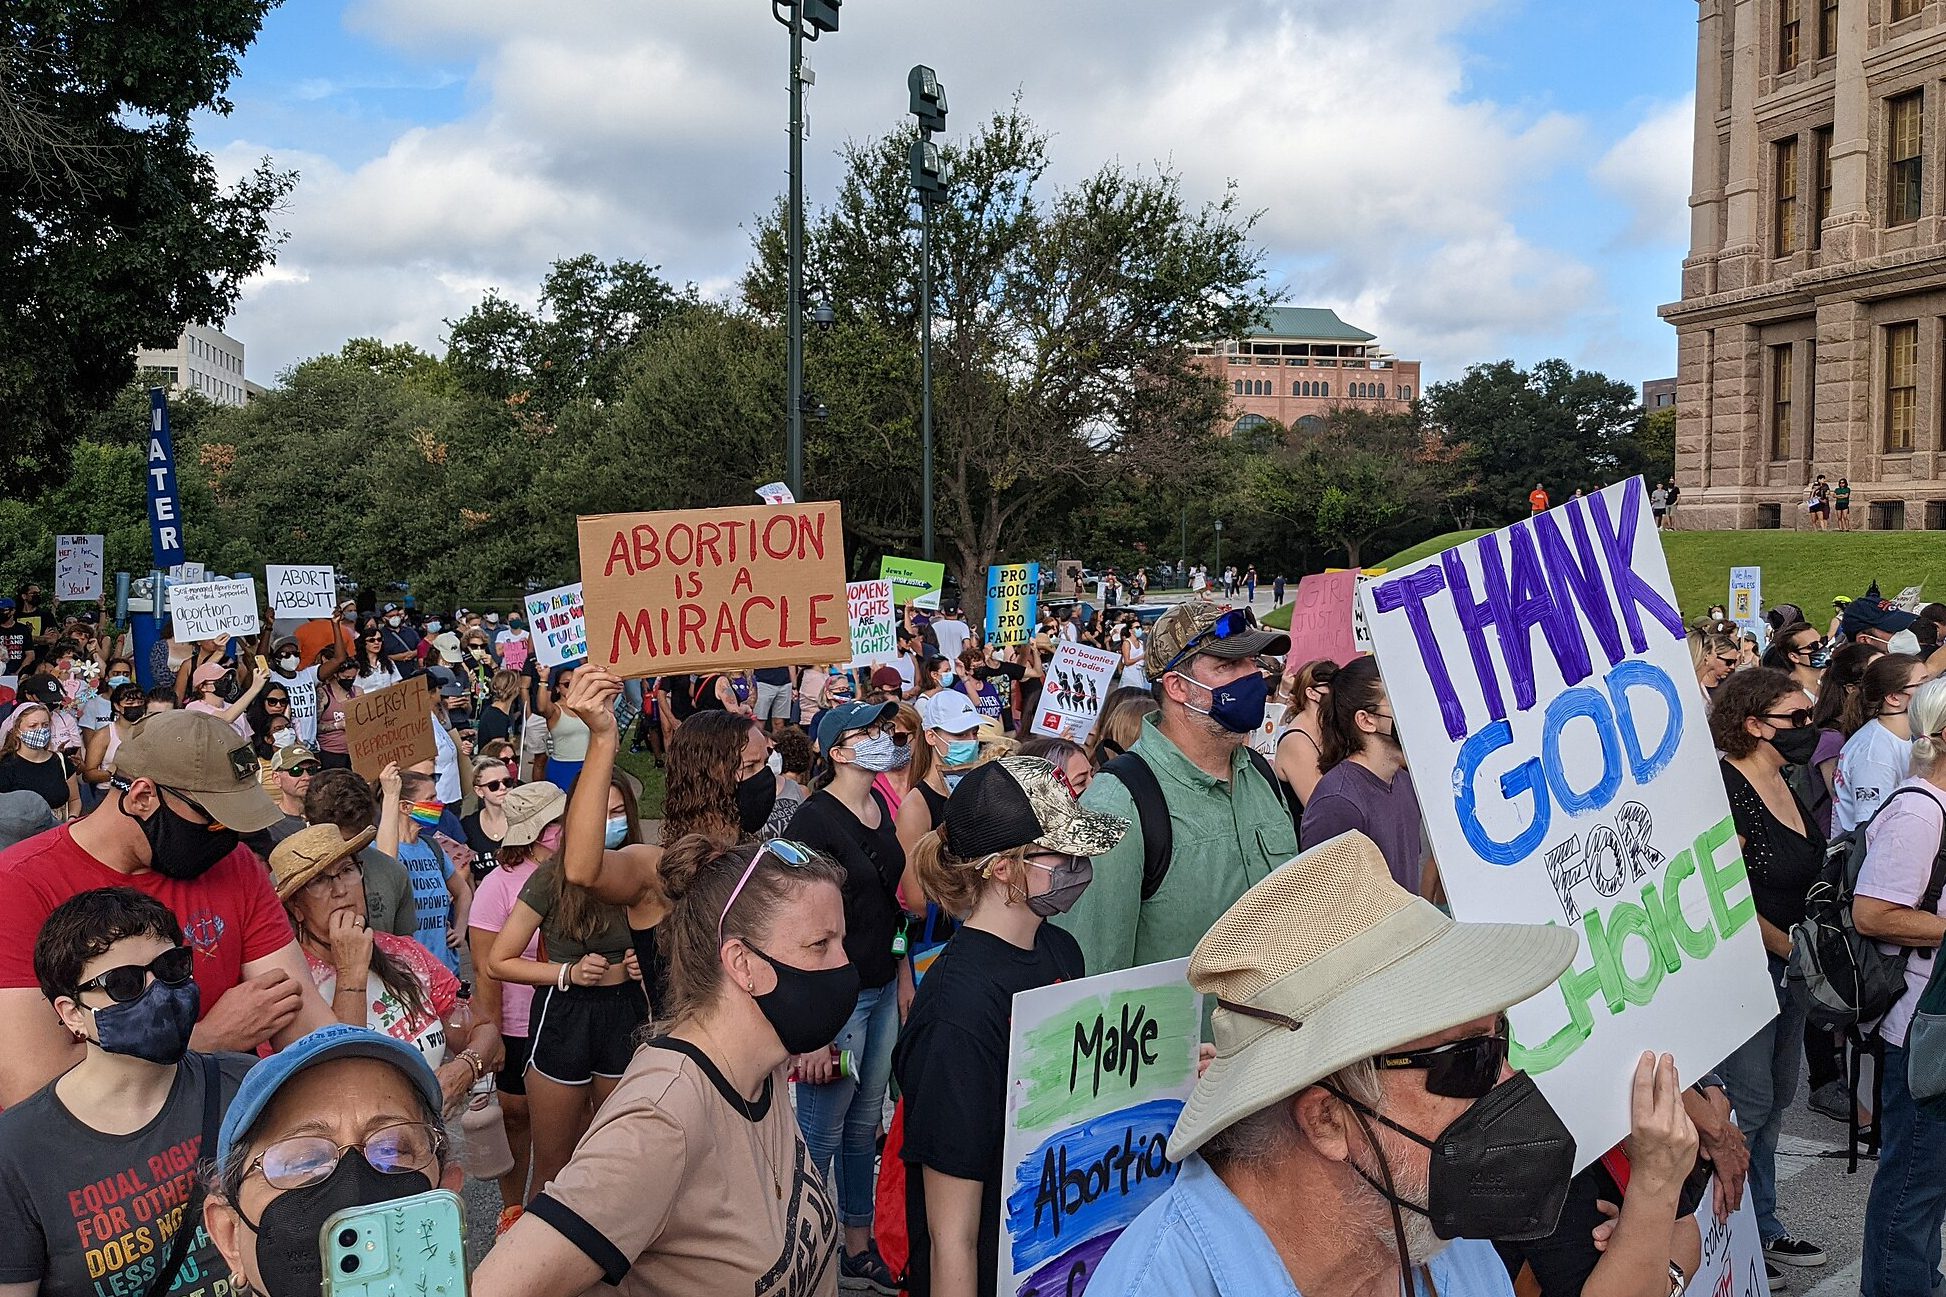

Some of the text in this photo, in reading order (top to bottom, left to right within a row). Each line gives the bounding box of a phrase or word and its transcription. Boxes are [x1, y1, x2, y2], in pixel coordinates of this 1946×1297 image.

[603, 512, 825, 577] ABORTION
[281, 569, 330, 590] ABORT
[675, 568, 753, 599] IS A
[988, 583, 1037, 599] CHOICE
[1000, 569, 1027, 583] PRO
[275, 591, 334, 610] ABBOTT
[1005, 600, 1020, 612] IS
[1372, 474, 1686, 741] THANK
[609, 594, 842, 664] MIRACLE
[859, 616, 875, 626] ARE
[987, 628, 1035, 644] FAMILY
[998, 614, 1025, 628] PRO
[1060, 645, 1115, 666] NO bounties
[1062, 657, 1105, 673] on bodies
[355, 686, 408, 726] CLERGY
[354, 717, 428, 760] REPRODUCTIVE
[1453, 660, 1683, 866] GOD
[1544, 801, 1666, 926] FOR
[68, 1167, 148, 1218] EQUAL
[76, 1206, 130, 1249] FOR
[85, 1226, 155, 1279] DOES
[93, 1255, 156, 1297] LESS
